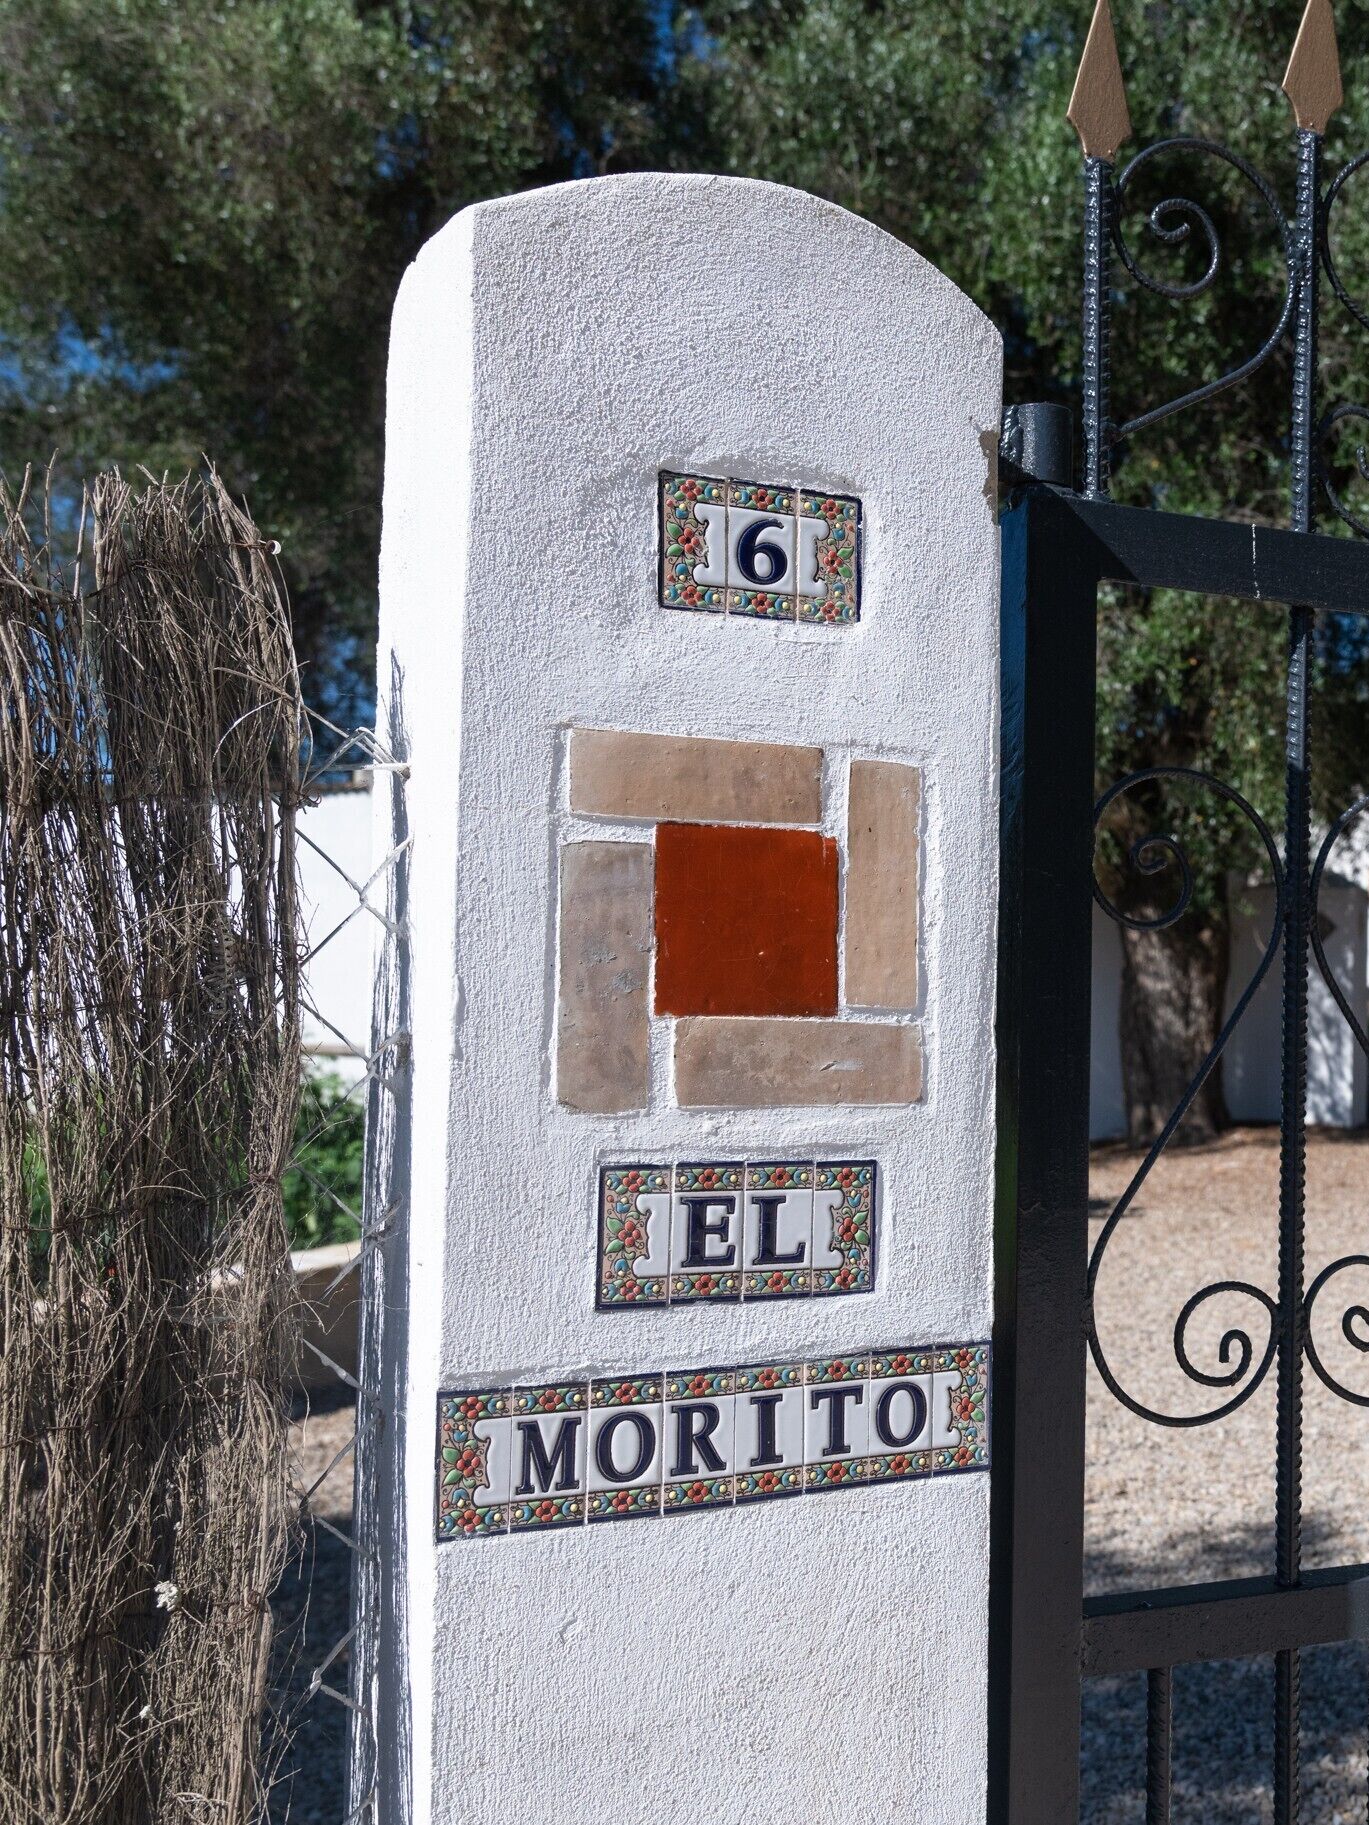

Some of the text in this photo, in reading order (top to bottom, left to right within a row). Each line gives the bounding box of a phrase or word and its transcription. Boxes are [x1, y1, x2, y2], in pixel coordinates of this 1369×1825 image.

[737, 518, 788, 585] 6
[680, 1196, 806, 1268] EL
[514, 1382, 927, 1496] MORITO
